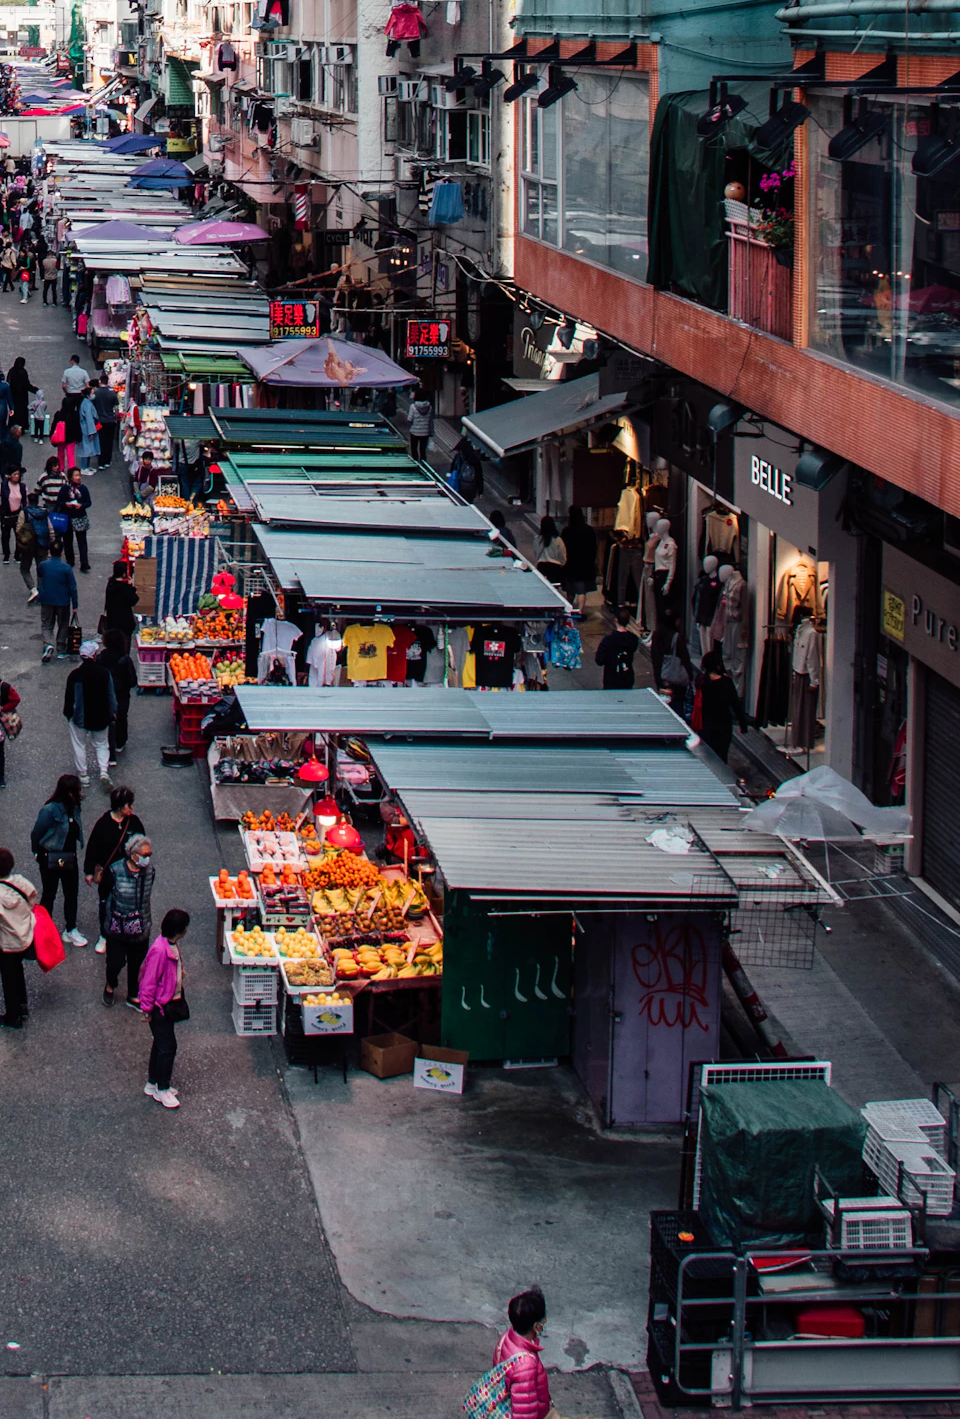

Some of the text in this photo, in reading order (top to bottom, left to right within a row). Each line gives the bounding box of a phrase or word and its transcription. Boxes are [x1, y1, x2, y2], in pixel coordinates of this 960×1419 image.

[273, 326, 316, 336] 91755993
[409, 345, 448, 356] 91755993
[751, 454, 793, 505] BELLE
[911, 593, 958, 651] Pure
